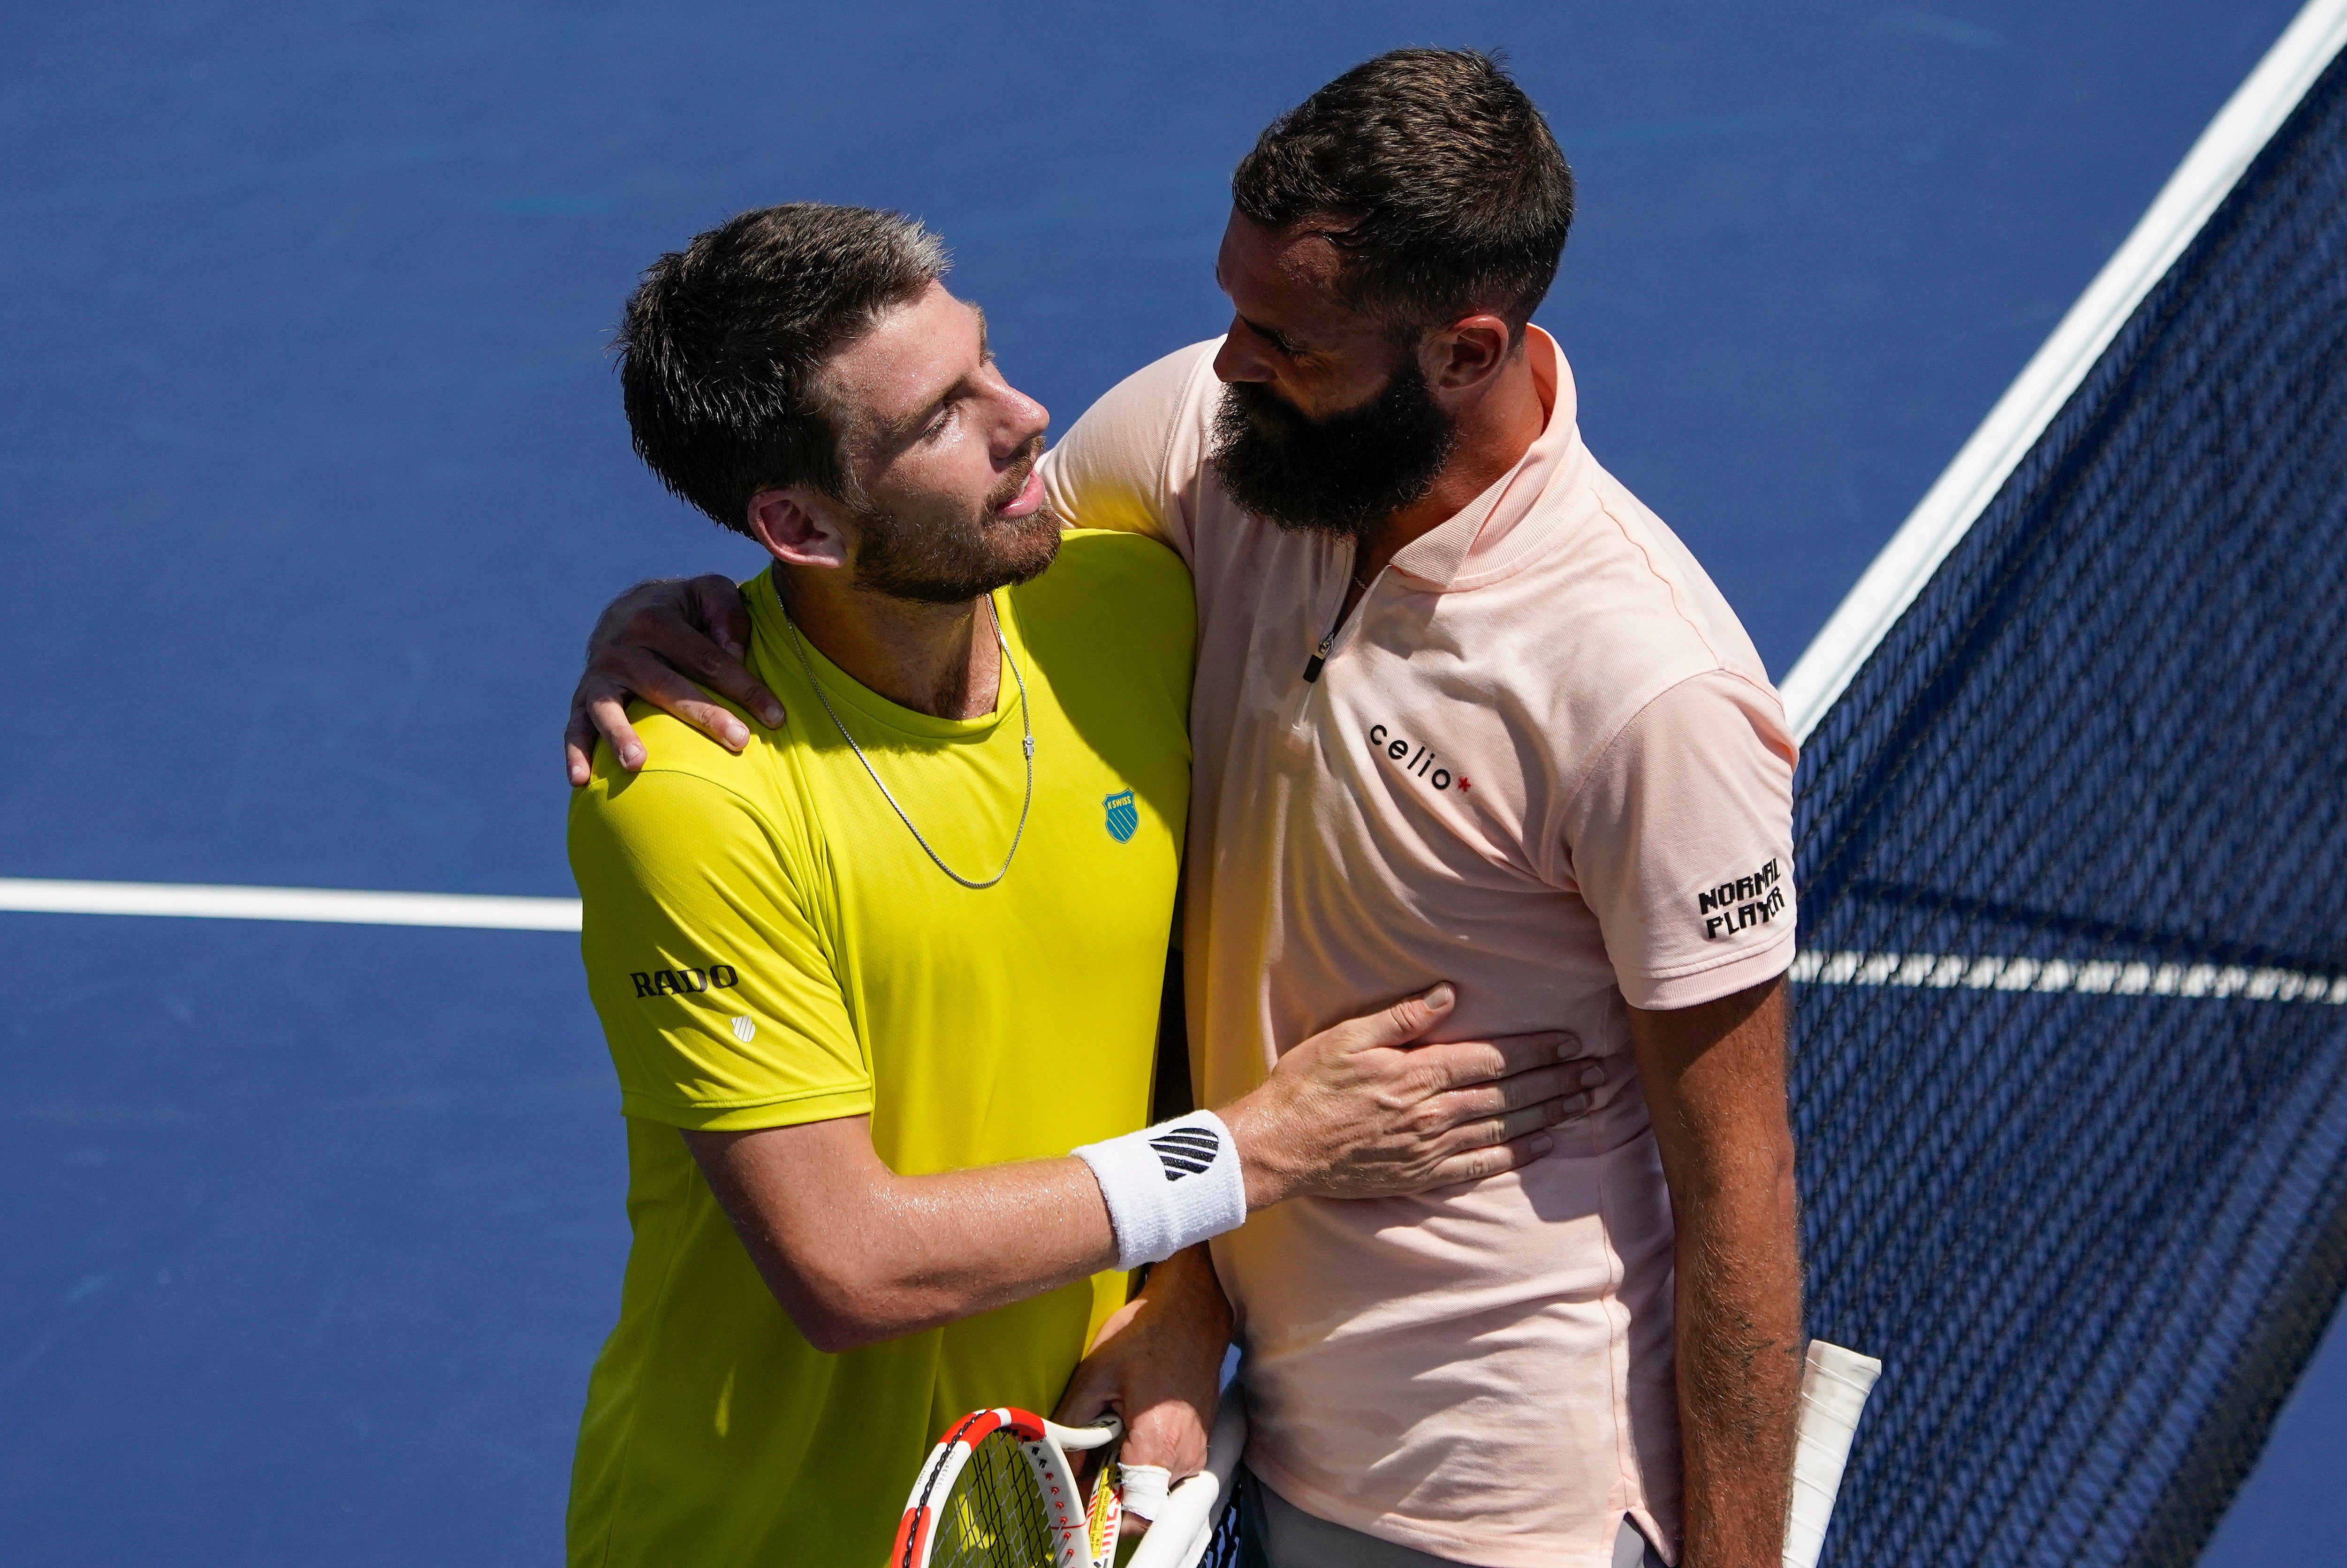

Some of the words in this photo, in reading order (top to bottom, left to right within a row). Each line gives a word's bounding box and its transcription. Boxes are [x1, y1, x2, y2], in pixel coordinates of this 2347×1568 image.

[1370, 724, 1451, 790] celio
[1698, 857, 1781, 915] NORMAL
[1706, 886, 1785, 939] PLAYER
[630, 965, 739, 999] RADO
